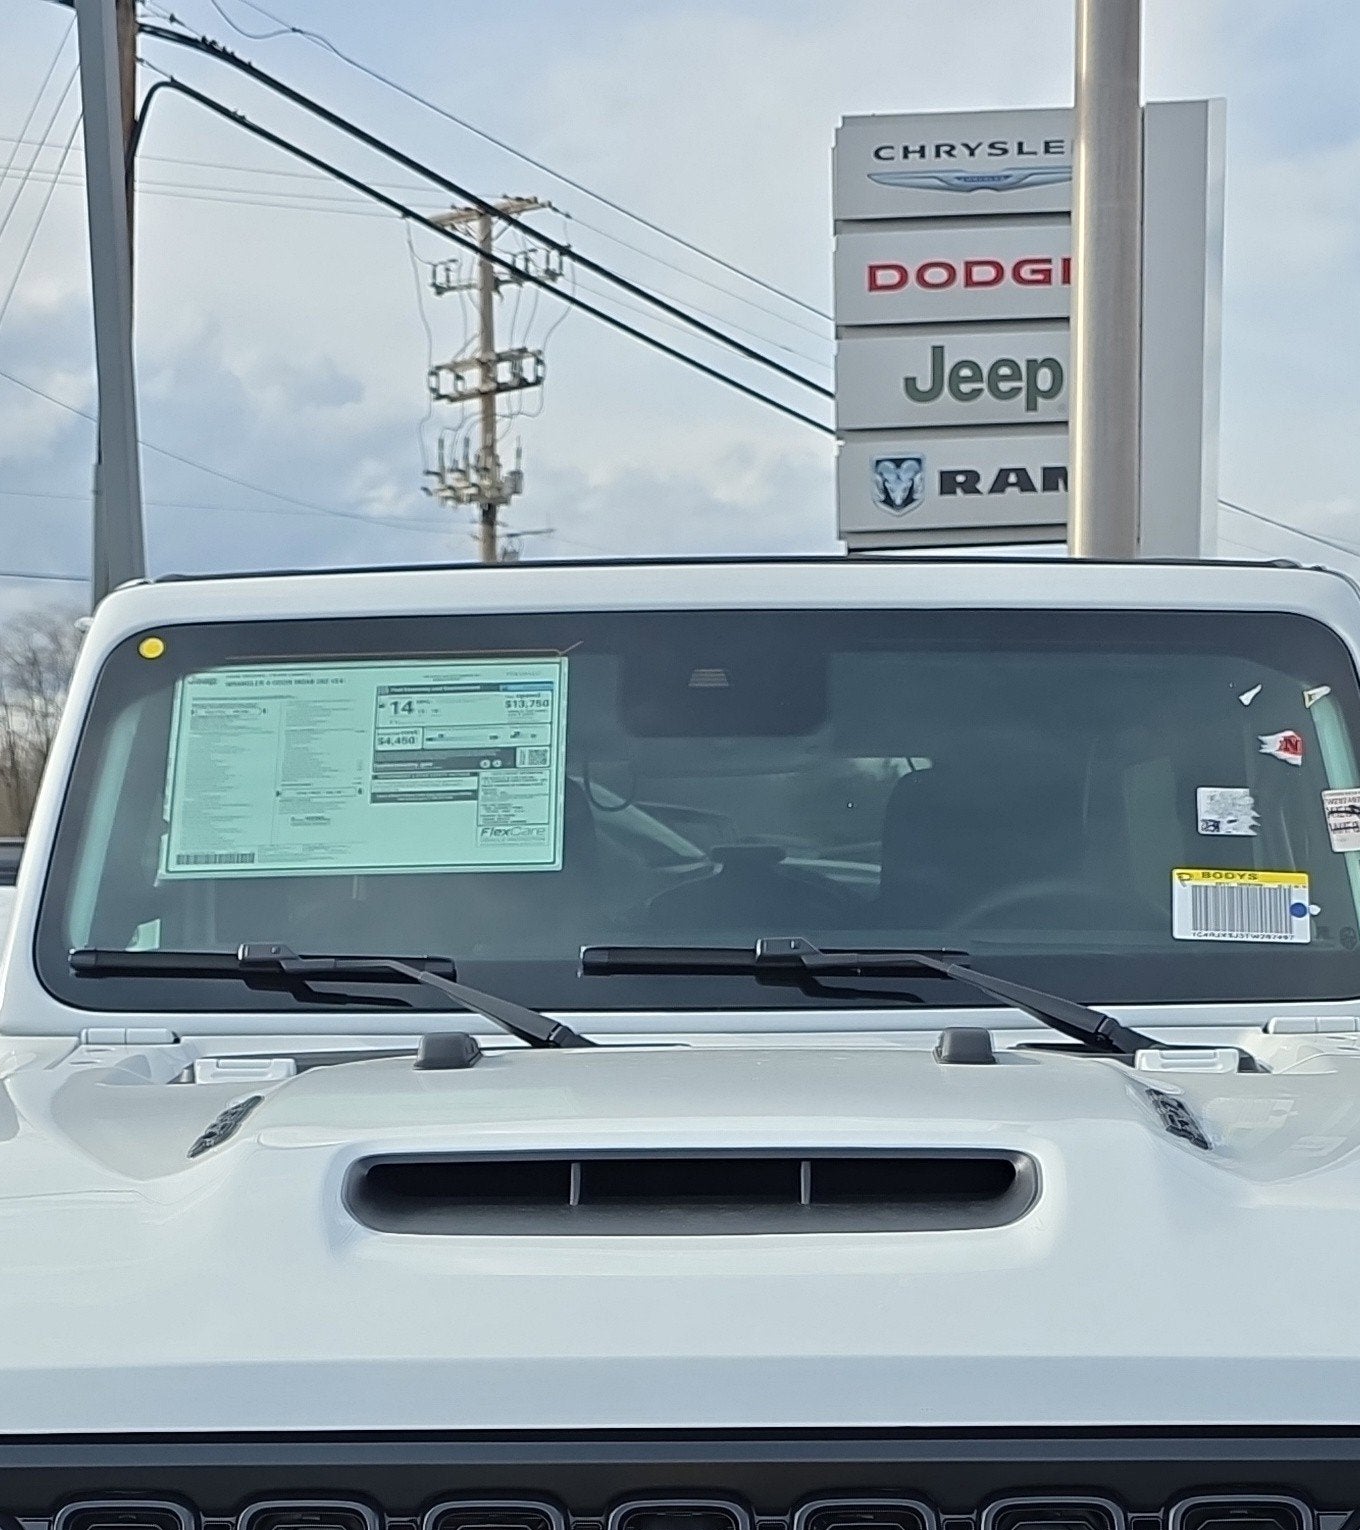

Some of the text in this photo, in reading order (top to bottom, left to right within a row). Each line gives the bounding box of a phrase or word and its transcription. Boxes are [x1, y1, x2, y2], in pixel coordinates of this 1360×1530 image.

[873, 139, 1072, 162] CHRYSLE
[903, 345, 1064, 412] Jeep
[390, 701, 414, 715] 14
